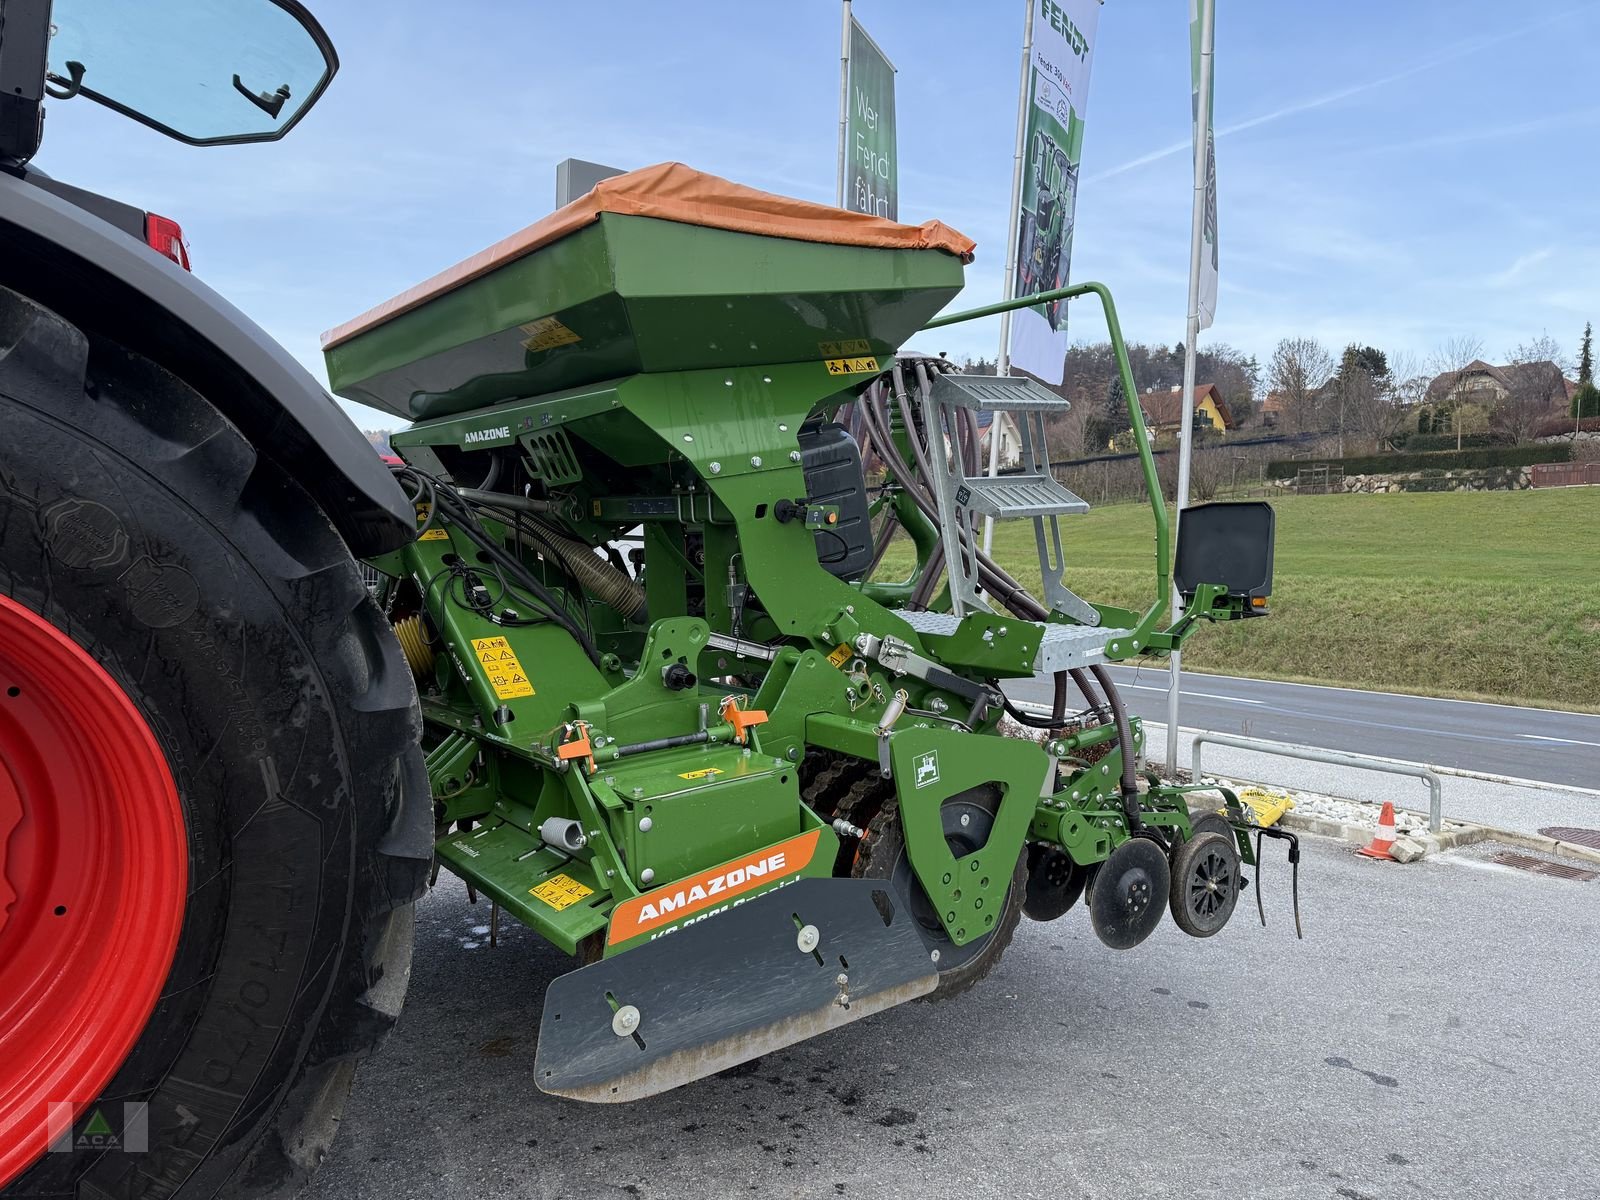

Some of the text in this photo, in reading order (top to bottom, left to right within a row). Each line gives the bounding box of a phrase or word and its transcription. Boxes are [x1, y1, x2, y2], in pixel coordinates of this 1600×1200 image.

[1042, 0, 1090, 64] FENDT
[1038, 52, 1053, 74] Fendt
[855, 85, 879, 132] Wer
[856, 131, 889, 181] Fend
[855, 175, 889, 219] fährt
[465, 426, 510, 443] AMAZONE
[637, 852, 786, 925] AMAZONE
